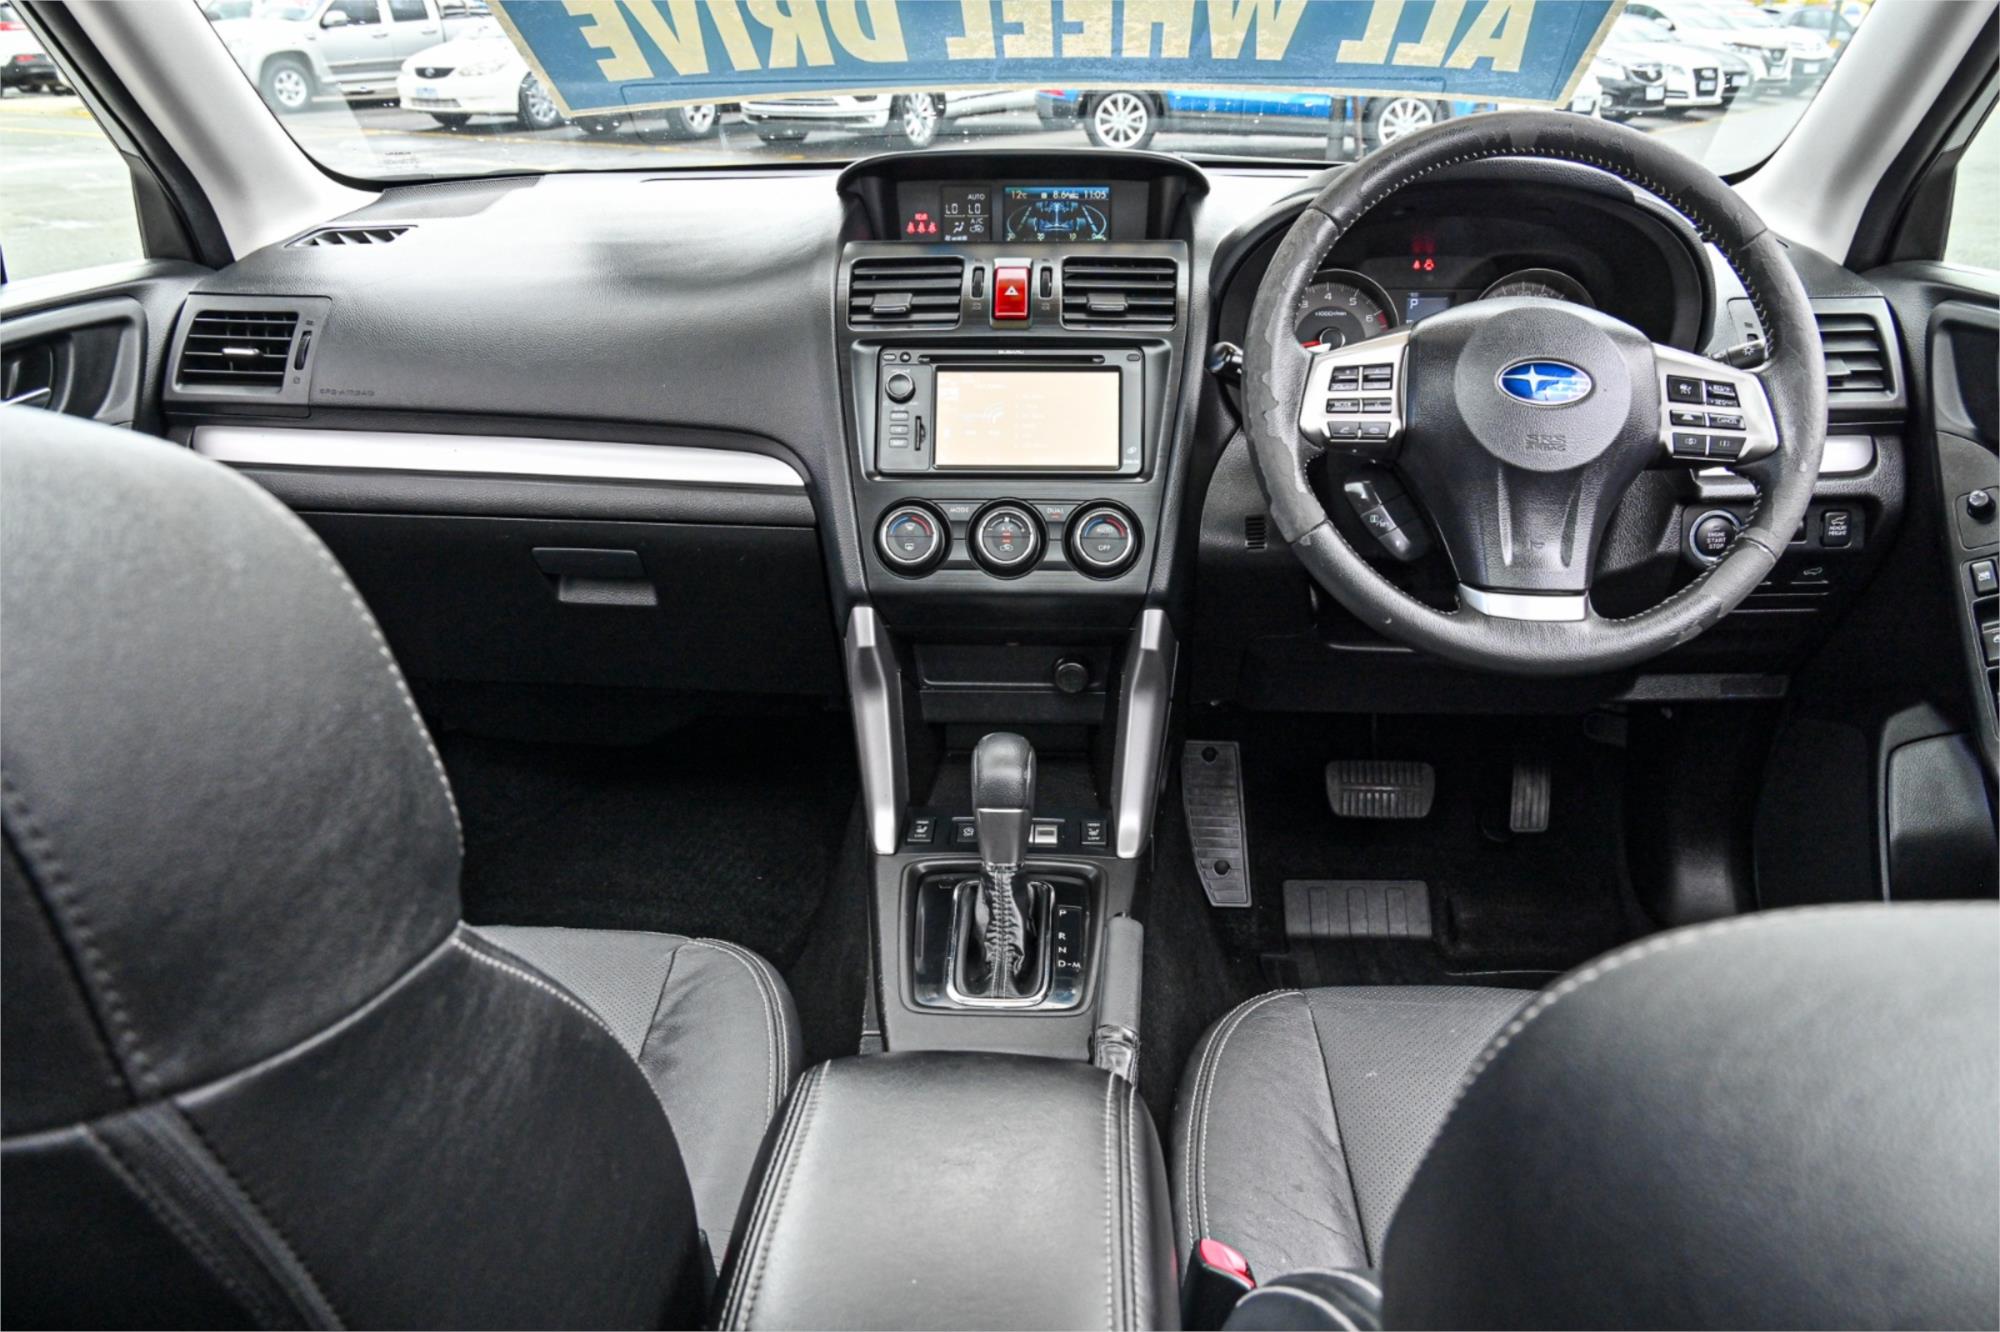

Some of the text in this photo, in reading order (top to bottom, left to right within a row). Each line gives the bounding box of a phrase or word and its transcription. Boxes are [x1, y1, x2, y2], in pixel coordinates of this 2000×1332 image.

[967, 193, 986, 201] AUTO
[1084, 190, 1107, 200] 11:05
[1349, 298, 1357, 306] 5
[1409, 299, 1419, 309] P
[1366, 314, 1373, 322] 6
[1525, 434, 1567, 443] SRS
